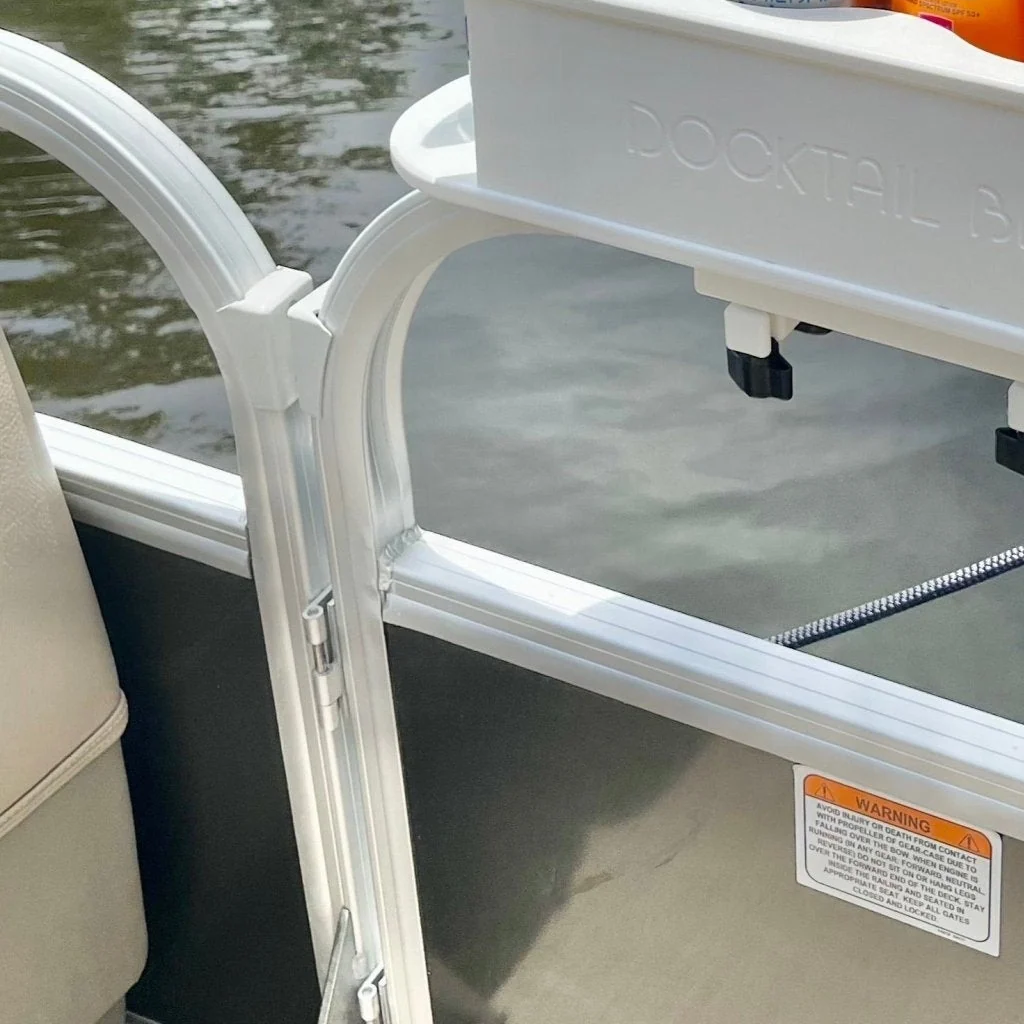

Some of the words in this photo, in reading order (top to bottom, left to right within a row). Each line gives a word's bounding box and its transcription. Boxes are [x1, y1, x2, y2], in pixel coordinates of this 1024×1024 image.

[626, 100, 940, 227] DOCKTAIL
[809, 826, 843, 844] RUNNING
[858, 844, 873, 854] ANY
[817, 803, 840, 816] AVOID
[842, 812, 870, 826] INJURY
[872, 822, 883, 830] OR
[885, 827, 911, 841] DEATH
[914, 837, 936, 850] FROM
[939, 845, 977, 864] CONTACT
[817, 812, 836, 823] WITH
[838, 819, 883, 840] PROPELLER
[898, 840, 945, 862] GEAR-CASE
[947, 858, 963, 869] DUE
[966, 864, 977, 873] TO
[856, 796, 930, 833] WARNING
[809, 844, 830, 856] OVER
[832, 852, 846, 862] THE
[849, 858, 888, 877] FORWARD
[890, 873, 905, 883] END
[921, 884, 936, 894] THE
[964, 901, 984, 912] STAY
[815, 820, 847, 836] FALLING
[849, 832, 870, 844] OVER
[874, 840, 888, 851] THE
[913, 854, 936, 868] WHEN
[939, 864, 968, 880] ENGINE
[858, 852, 869, 861] DO
[870, 858, 886, 867] NOT
[903, 869, 914, 878] ON
[916, 874, 928, 883] OR
[930, 879, 952, 892] HANG
[955, 888, 976, 900] LEGS
[823, 867, 876, 891] APPROPRIATE
[926, 904, 940, 914] ALL
[943, 910, 970, 925] GATES
[853, 886, 884, 902] CLOSED
[886, 898, 902, 908] AND
[855, 869, 869, 879] THE
[872, 876, 903, 891] RAILING
[905, 888, 921, 898] AND
[924, 894, 954, 910] SEATED
